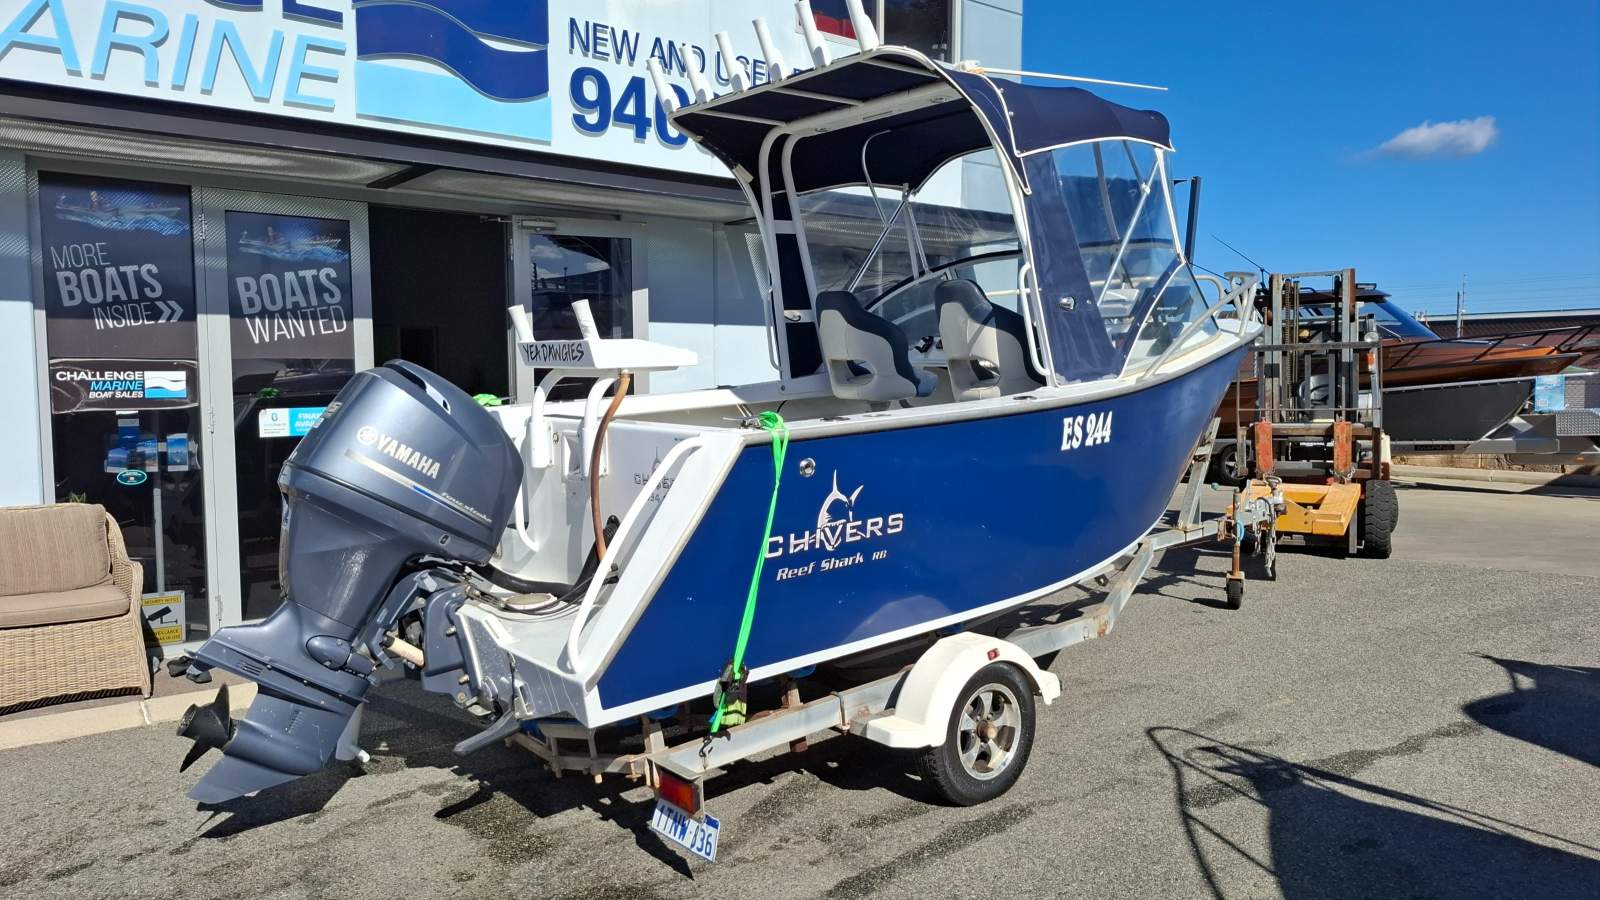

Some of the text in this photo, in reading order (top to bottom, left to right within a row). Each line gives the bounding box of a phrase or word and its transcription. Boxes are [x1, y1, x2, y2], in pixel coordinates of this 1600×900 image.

[569, 17, 772, 87] NEW AND USE
[50, 242, 112, 270] MORE
[56, 264, 163, 307] BOATS
[236, 267, 342, 315] BOATS
[93, 301, 157, 331] INSIDE
[245, 305, 347, 345] WANTED
[55, 370, 144, 381] CHALLENGE
[90, 380, 144, 391] MARINE
[88, 390, 144, 399] BOAT SALES
[1061, 415, 1084, 451] ES
[376, 434, 441, 480] YAMAHA
[764, 513, 904, 559] CHIVERS
[776, 561, 816, 582] Reef
[820, 552, 864, 572] Shark
